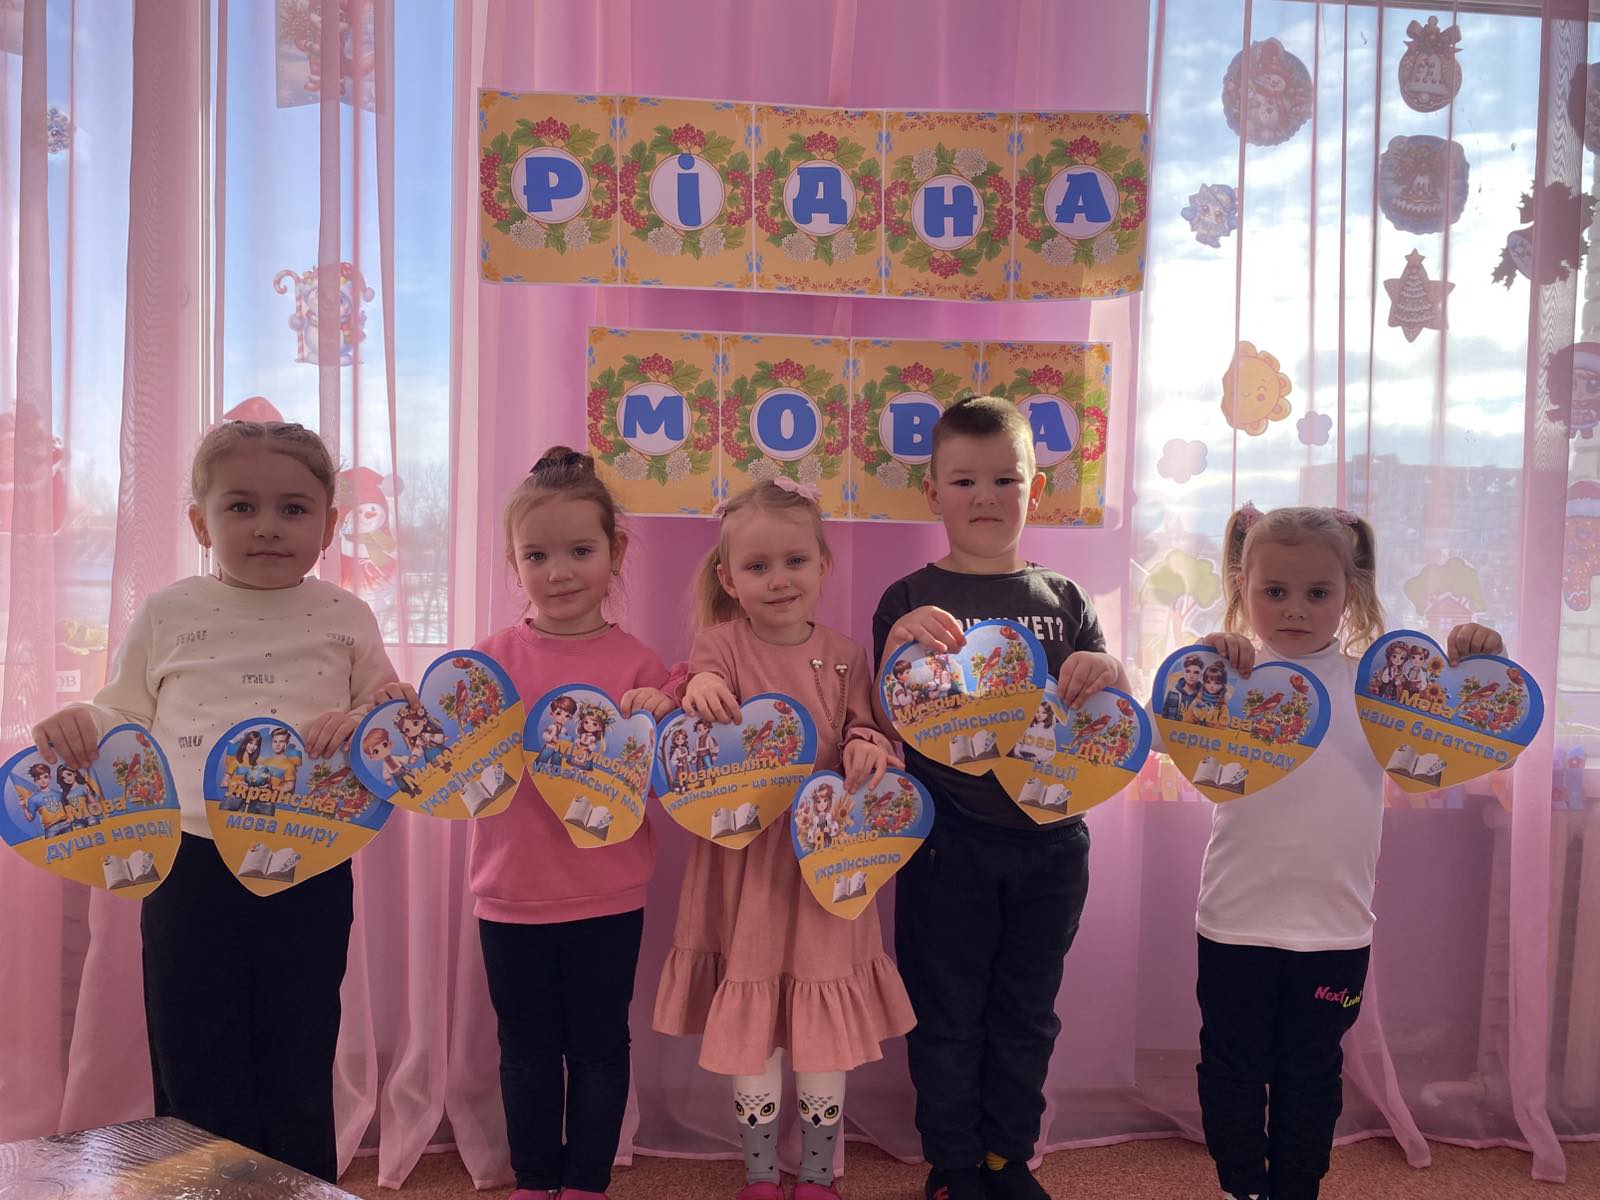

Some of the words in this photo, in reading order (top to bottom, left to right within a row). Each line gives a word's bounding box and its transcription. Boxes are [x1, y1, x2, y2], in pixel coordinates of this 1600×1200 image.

[623, 393, 1073, 456] МОВА
[1398, 689, 1455, 721] Мова
[914, 708, 1026, 745] українською
[1024, 733, 1056, 751] ова
[1359, 707, 1406, 732] наше
[1410, 720, 1510, 764] багатство
[1168, 729, 1222, 752] серце
[1227, 741, 1298, 772] народу
[419, 730, 522, 817] українською
[531, 760, 620, 802] українську
[752, 779, 768, 790] це
[1033, 760, 1078, 783] нації
[65, 797, 128, 822] Мова
[224, 781, 338, 815] Українська
[225, 814, 279, 834] мова
[282, 821, 340, 849] миру
[815, 853, 901, 885] українською
[1314, 985, 1349, 1004] Next
